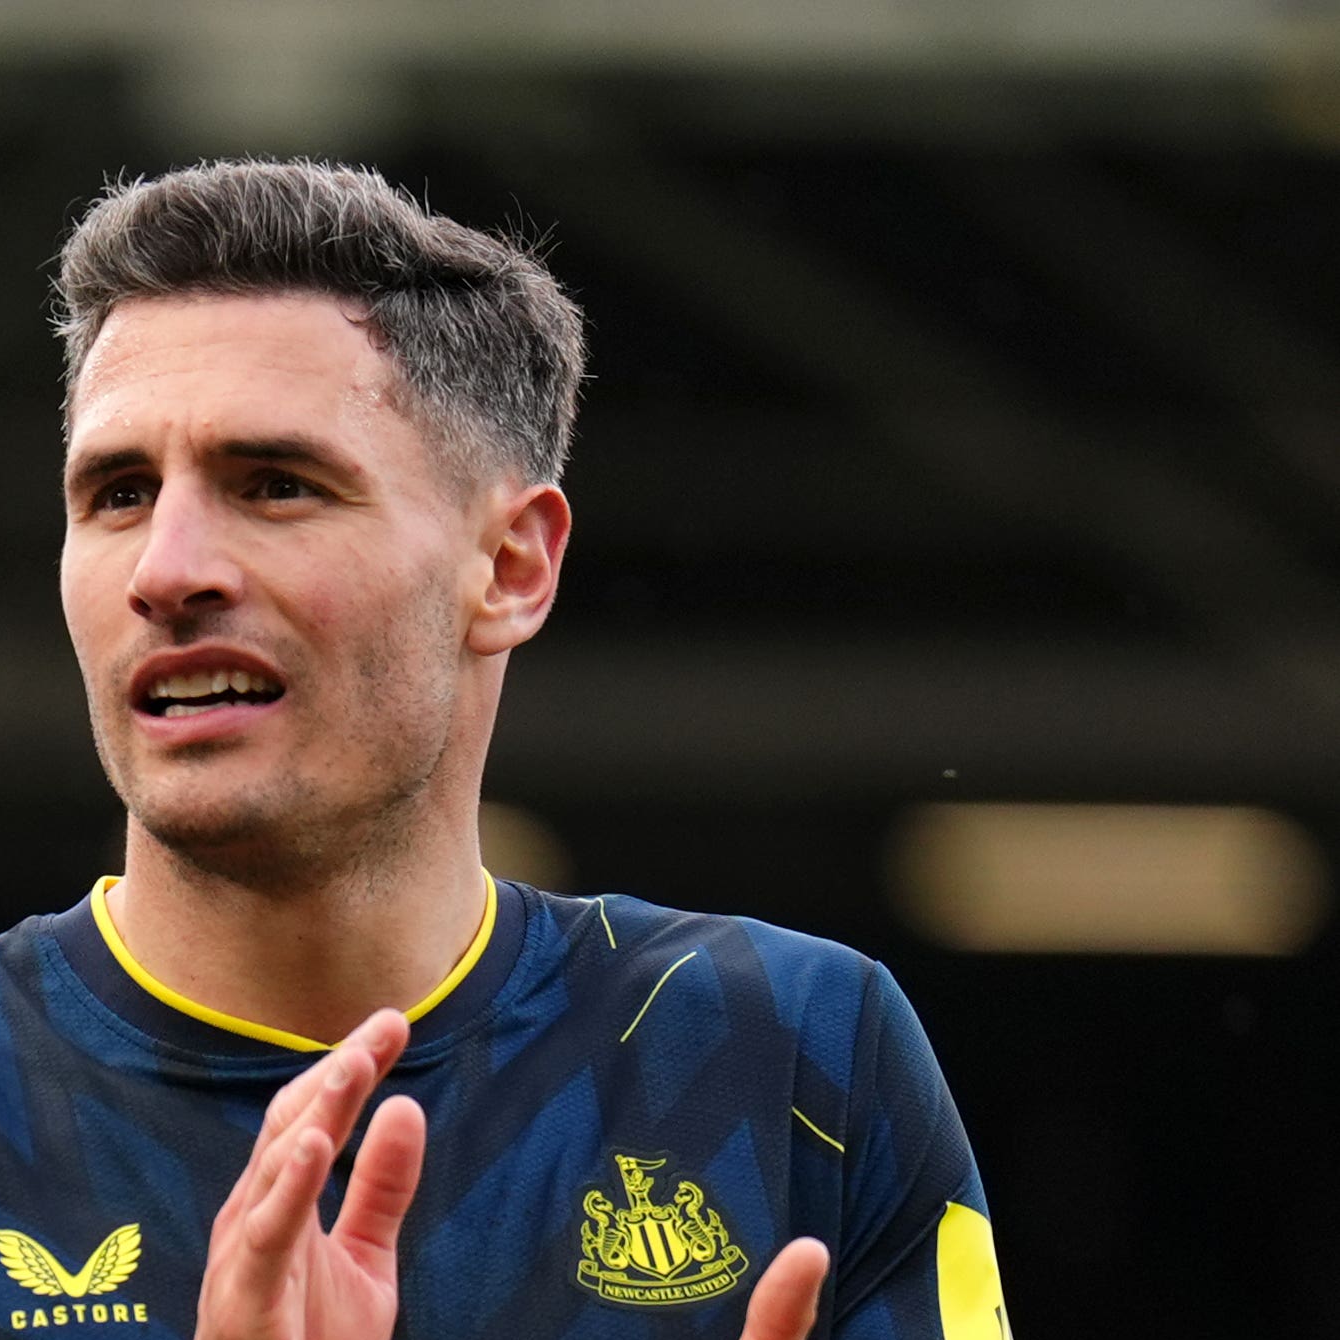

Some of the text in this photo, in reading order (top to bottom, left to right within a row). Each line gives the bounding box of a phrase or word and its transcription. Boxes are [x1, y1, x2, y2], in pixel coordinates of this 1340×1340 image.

[604, 1273, 731, 1301] NEWCASTLE UNITED
[11, 1303, 148, 1330] CASTORE
